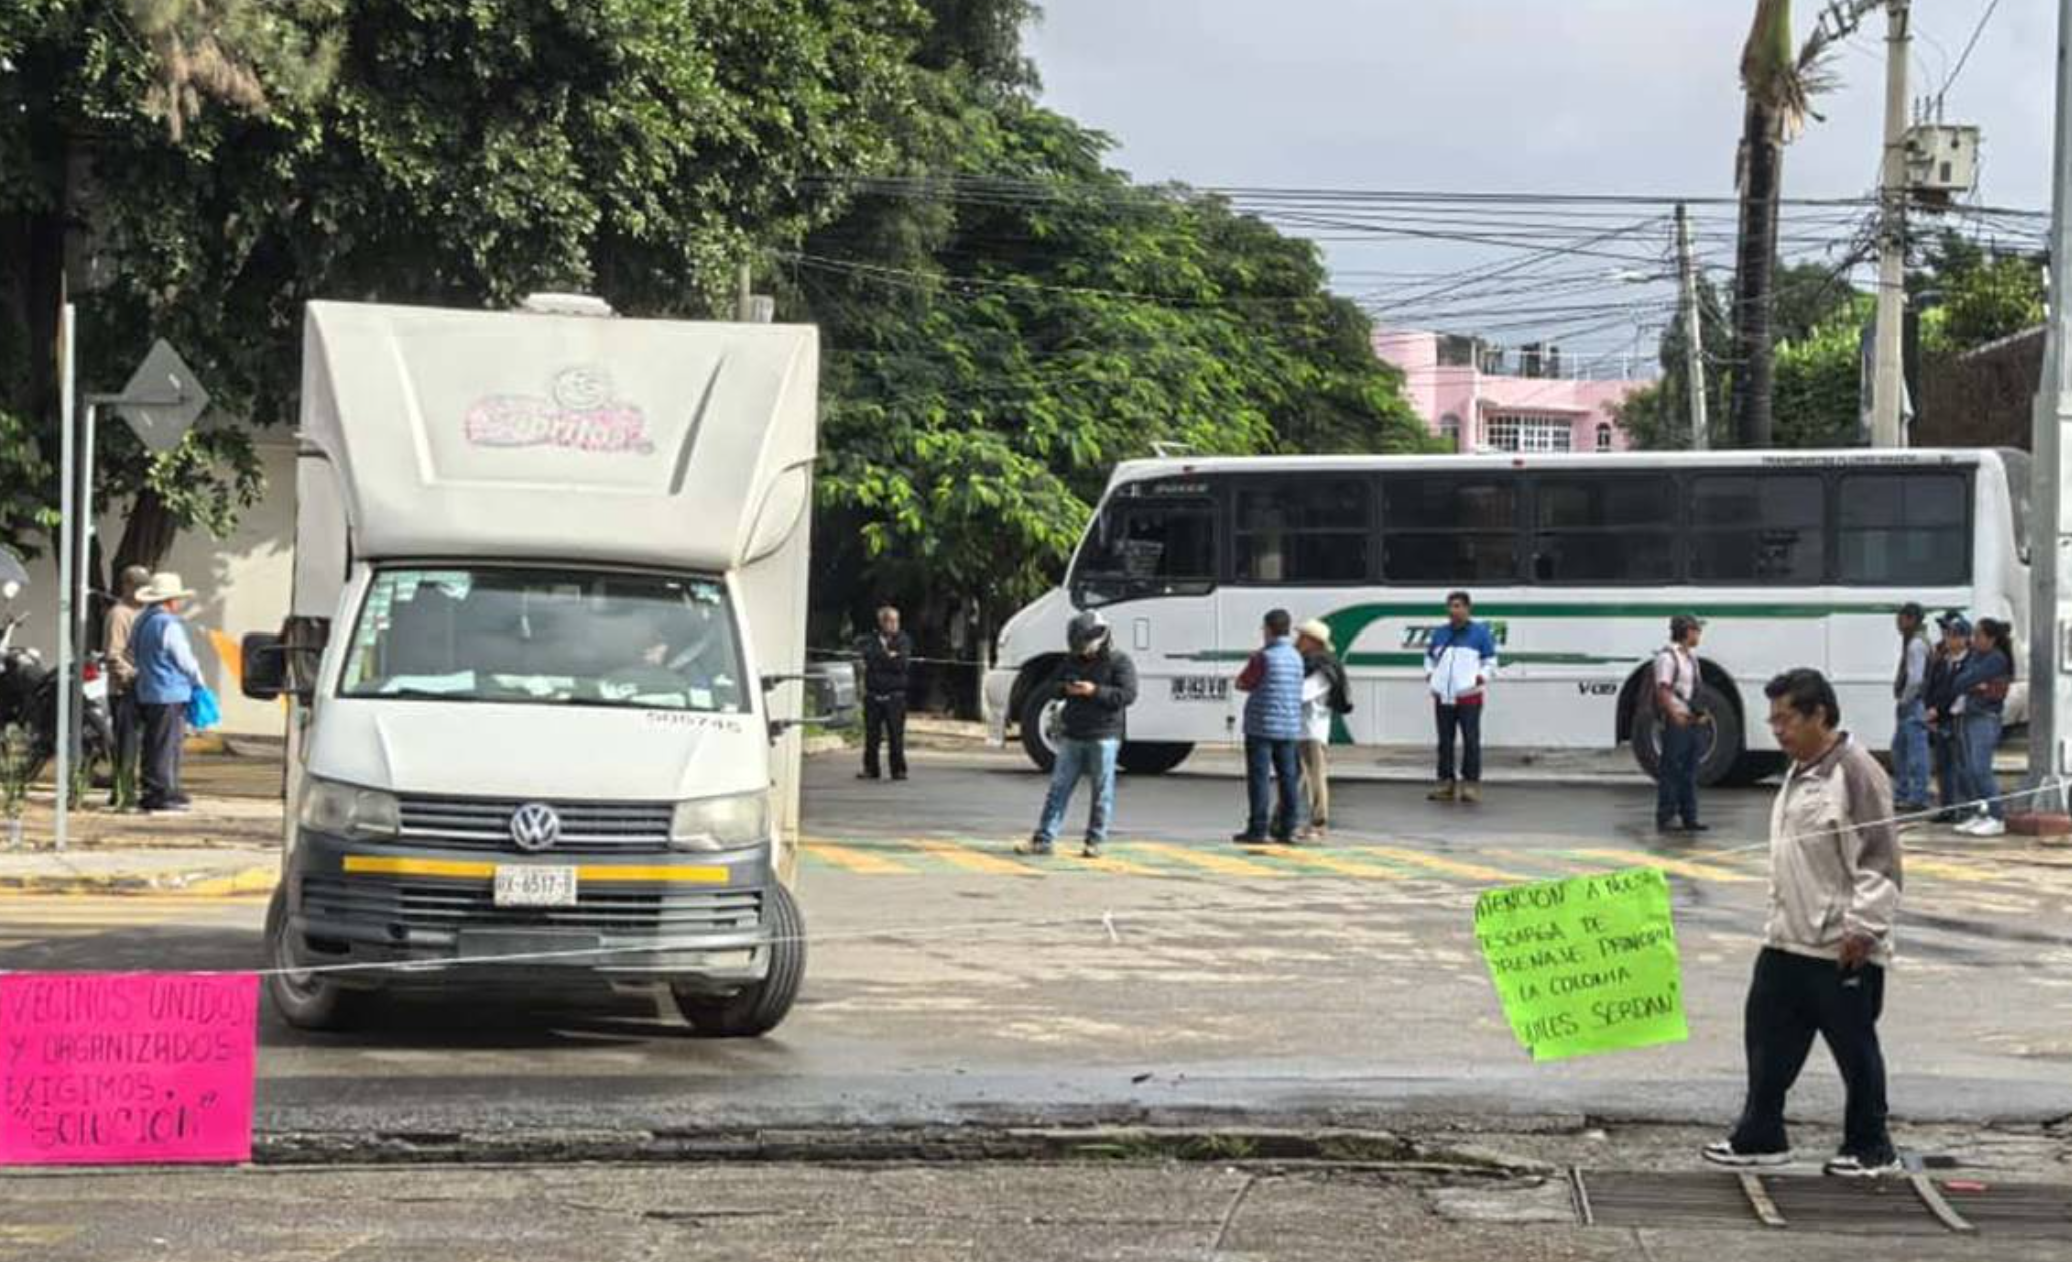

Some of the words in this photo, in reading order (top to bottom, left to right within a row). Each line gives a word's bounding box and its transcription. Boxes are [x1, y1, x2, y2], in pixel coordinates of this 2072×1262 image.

[1550, 966, 1632, 996] COLONIA
[9, 979, 131, 1023] VECINOS
[9, 1034, 27, 1066] Y
